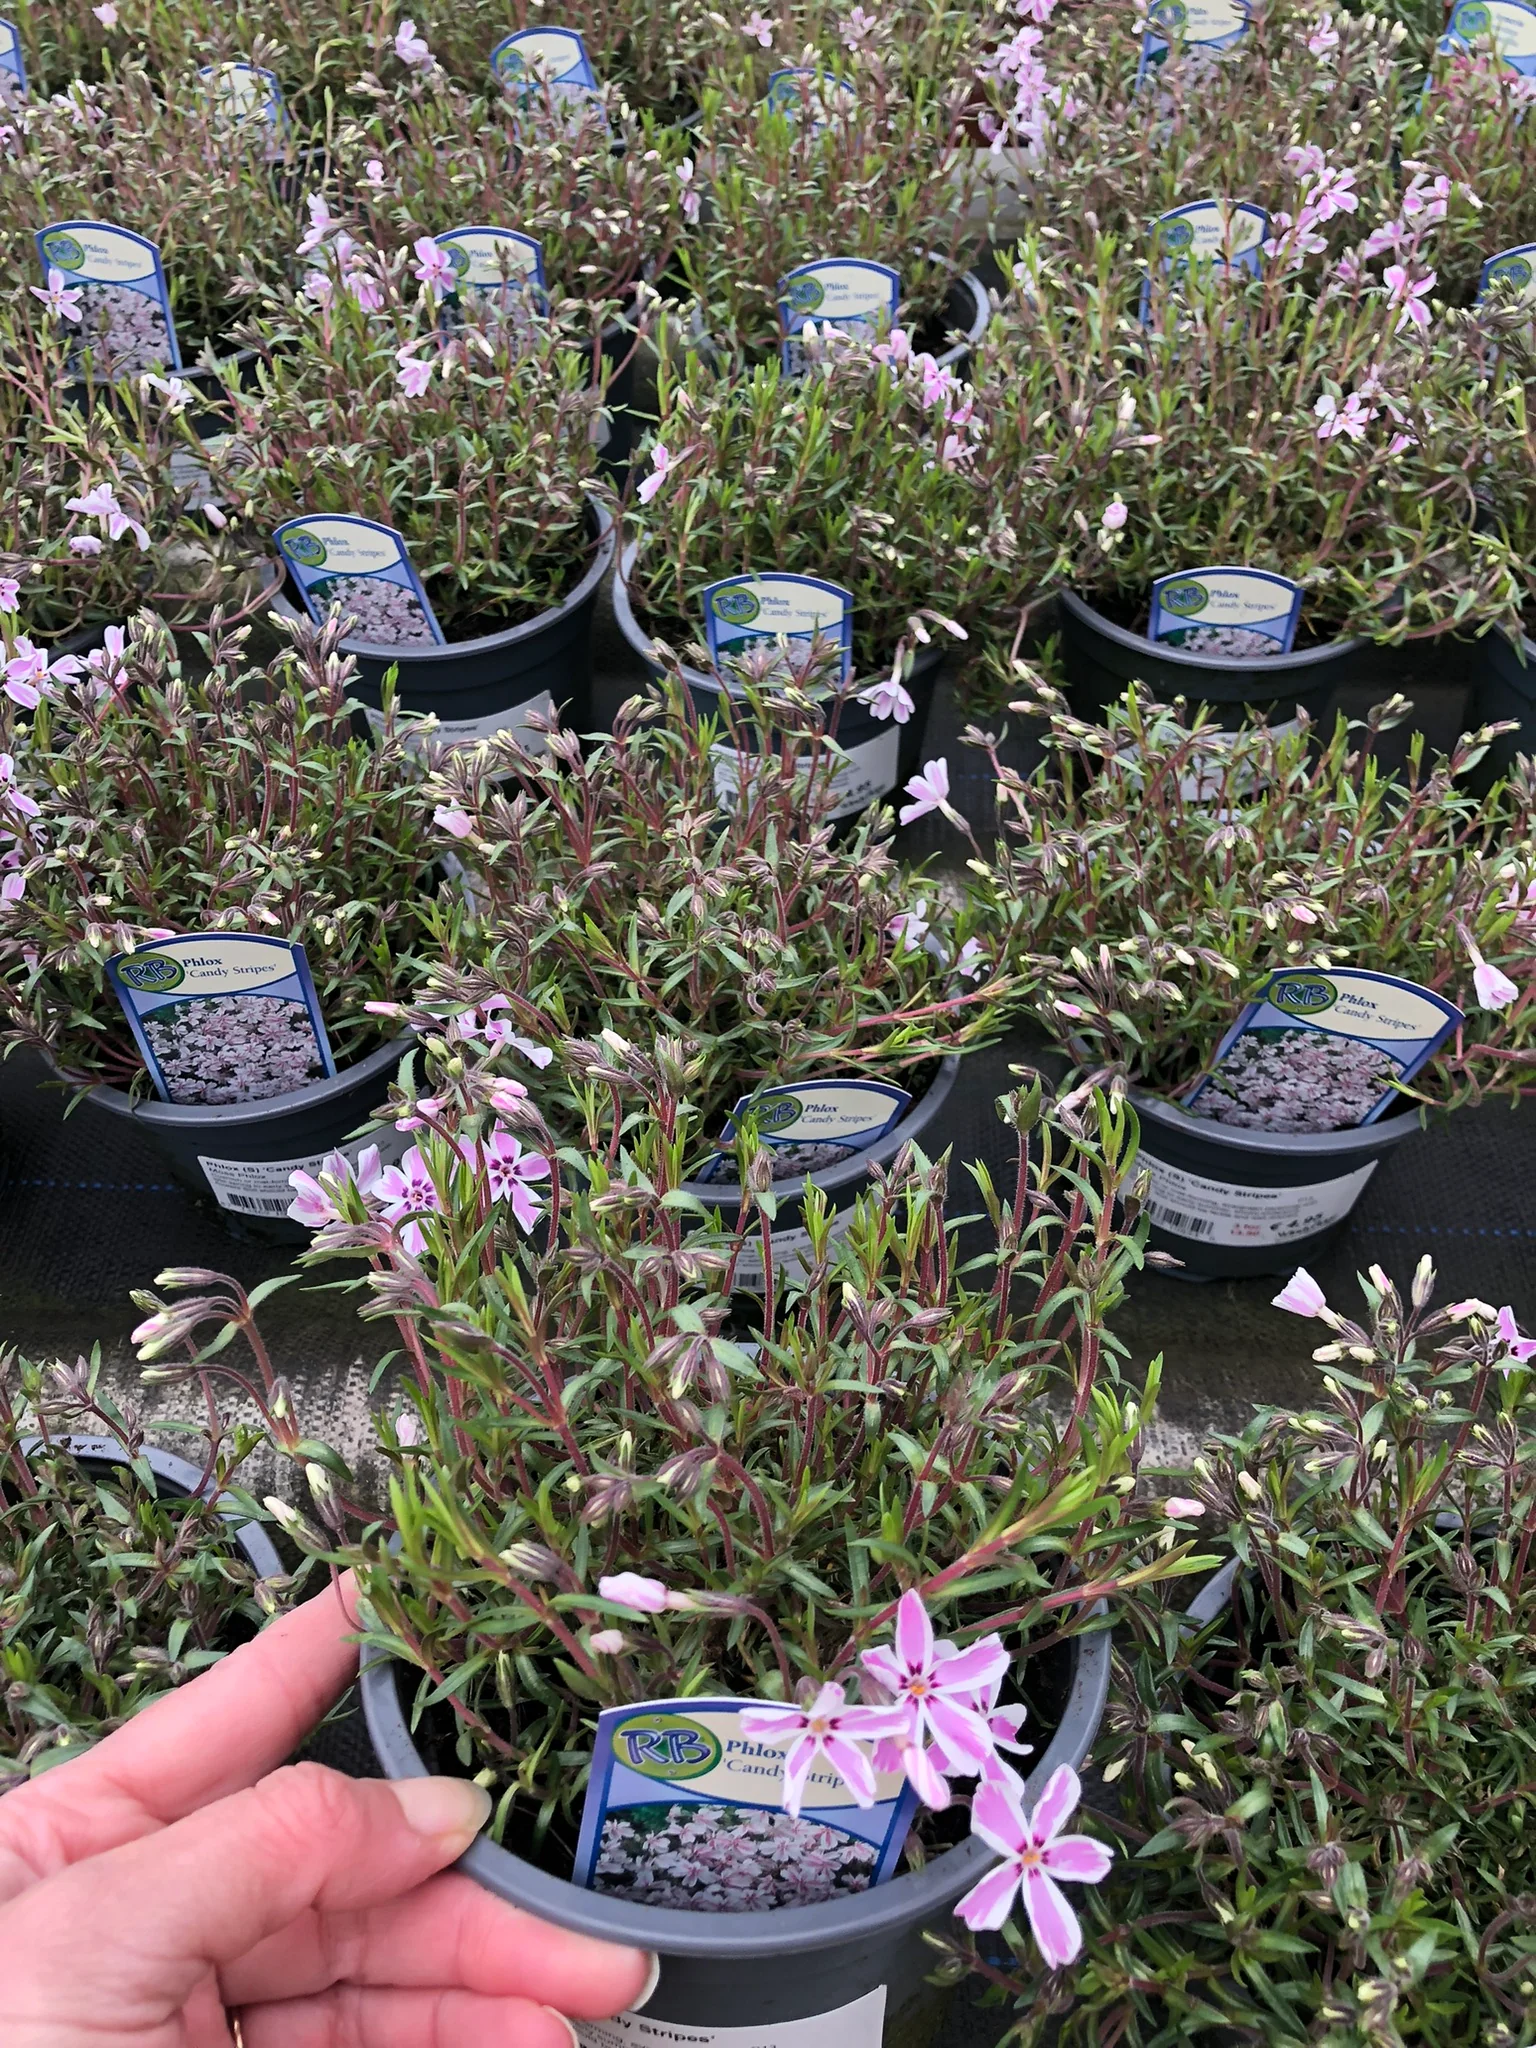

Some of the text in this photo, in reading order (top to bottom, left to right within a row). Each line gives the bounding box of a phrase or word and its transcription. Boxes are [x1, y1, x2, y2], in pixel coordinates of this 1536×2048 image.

[715, 593, 756, 618] RB
[1164, 586, 1203, 609] RB
[120, 959, 178, 988] RB
[183, 956, 223, 969] Phlox
[186, 963, 278, 980] 'Candy Stripes'
[1276, 982, 1331, 1006] RB
[1338, 991, 1379, 1010] Phlox
[1334, 1003, 1422, 1032] 'Candy Stripes'
[804, 1104, 840, 1113] Phlox
[620, 1728, 712, 1766] RB
[726, 1739, 787, 1761] Phlox
[639, 2023, 716, 2044] Stripes'
